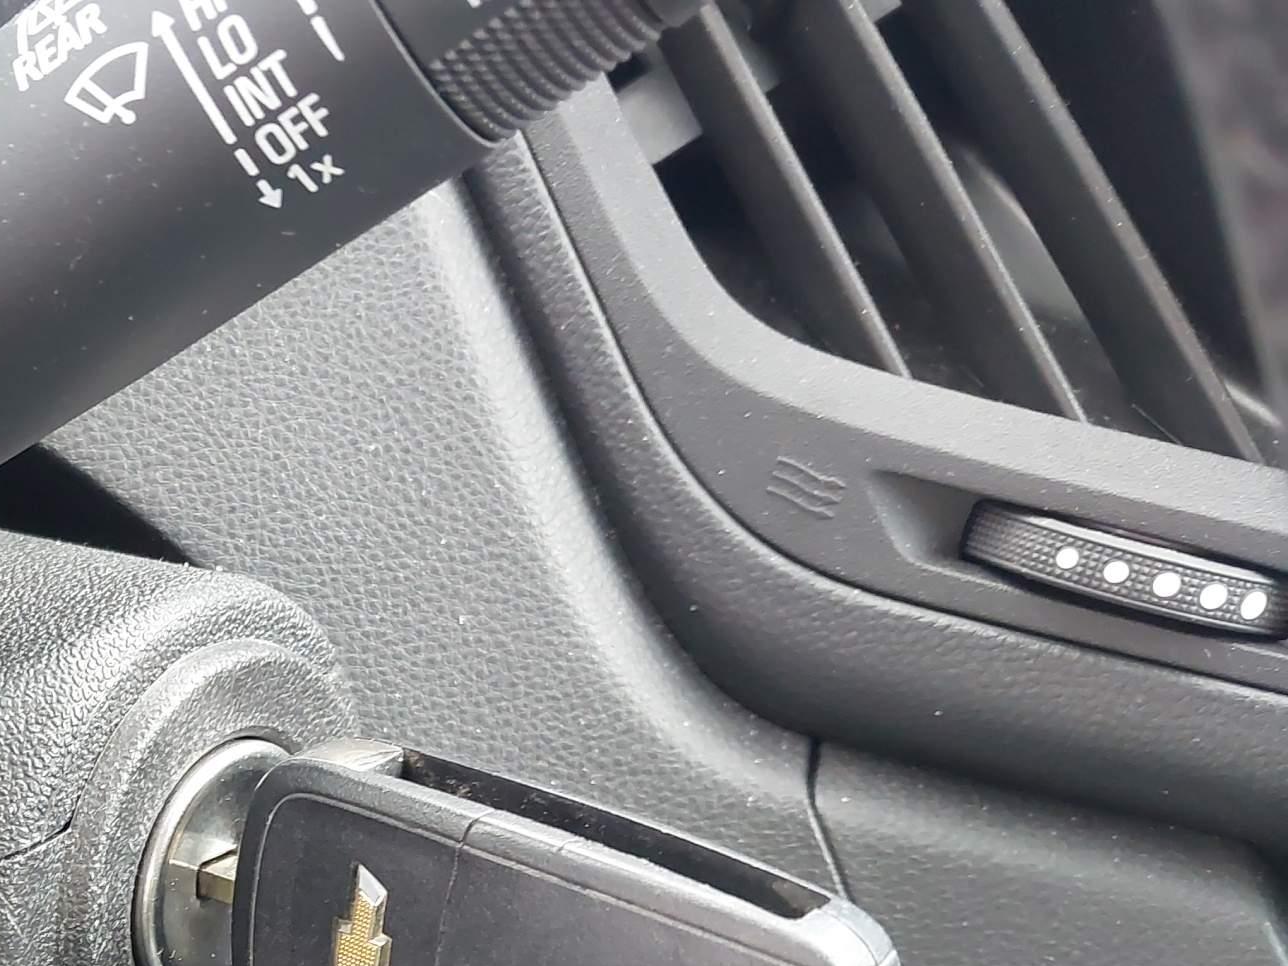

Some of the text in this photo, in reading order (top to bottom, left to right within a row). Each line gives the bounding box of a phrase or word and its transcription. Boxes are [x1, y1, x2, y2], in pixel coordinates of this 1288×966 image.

[12, 3, 107, 91] REAR
[197, 14, 258, 80] LO
[223, 49, 299, 127] INT
[254, 92, 330, 166] OFF
